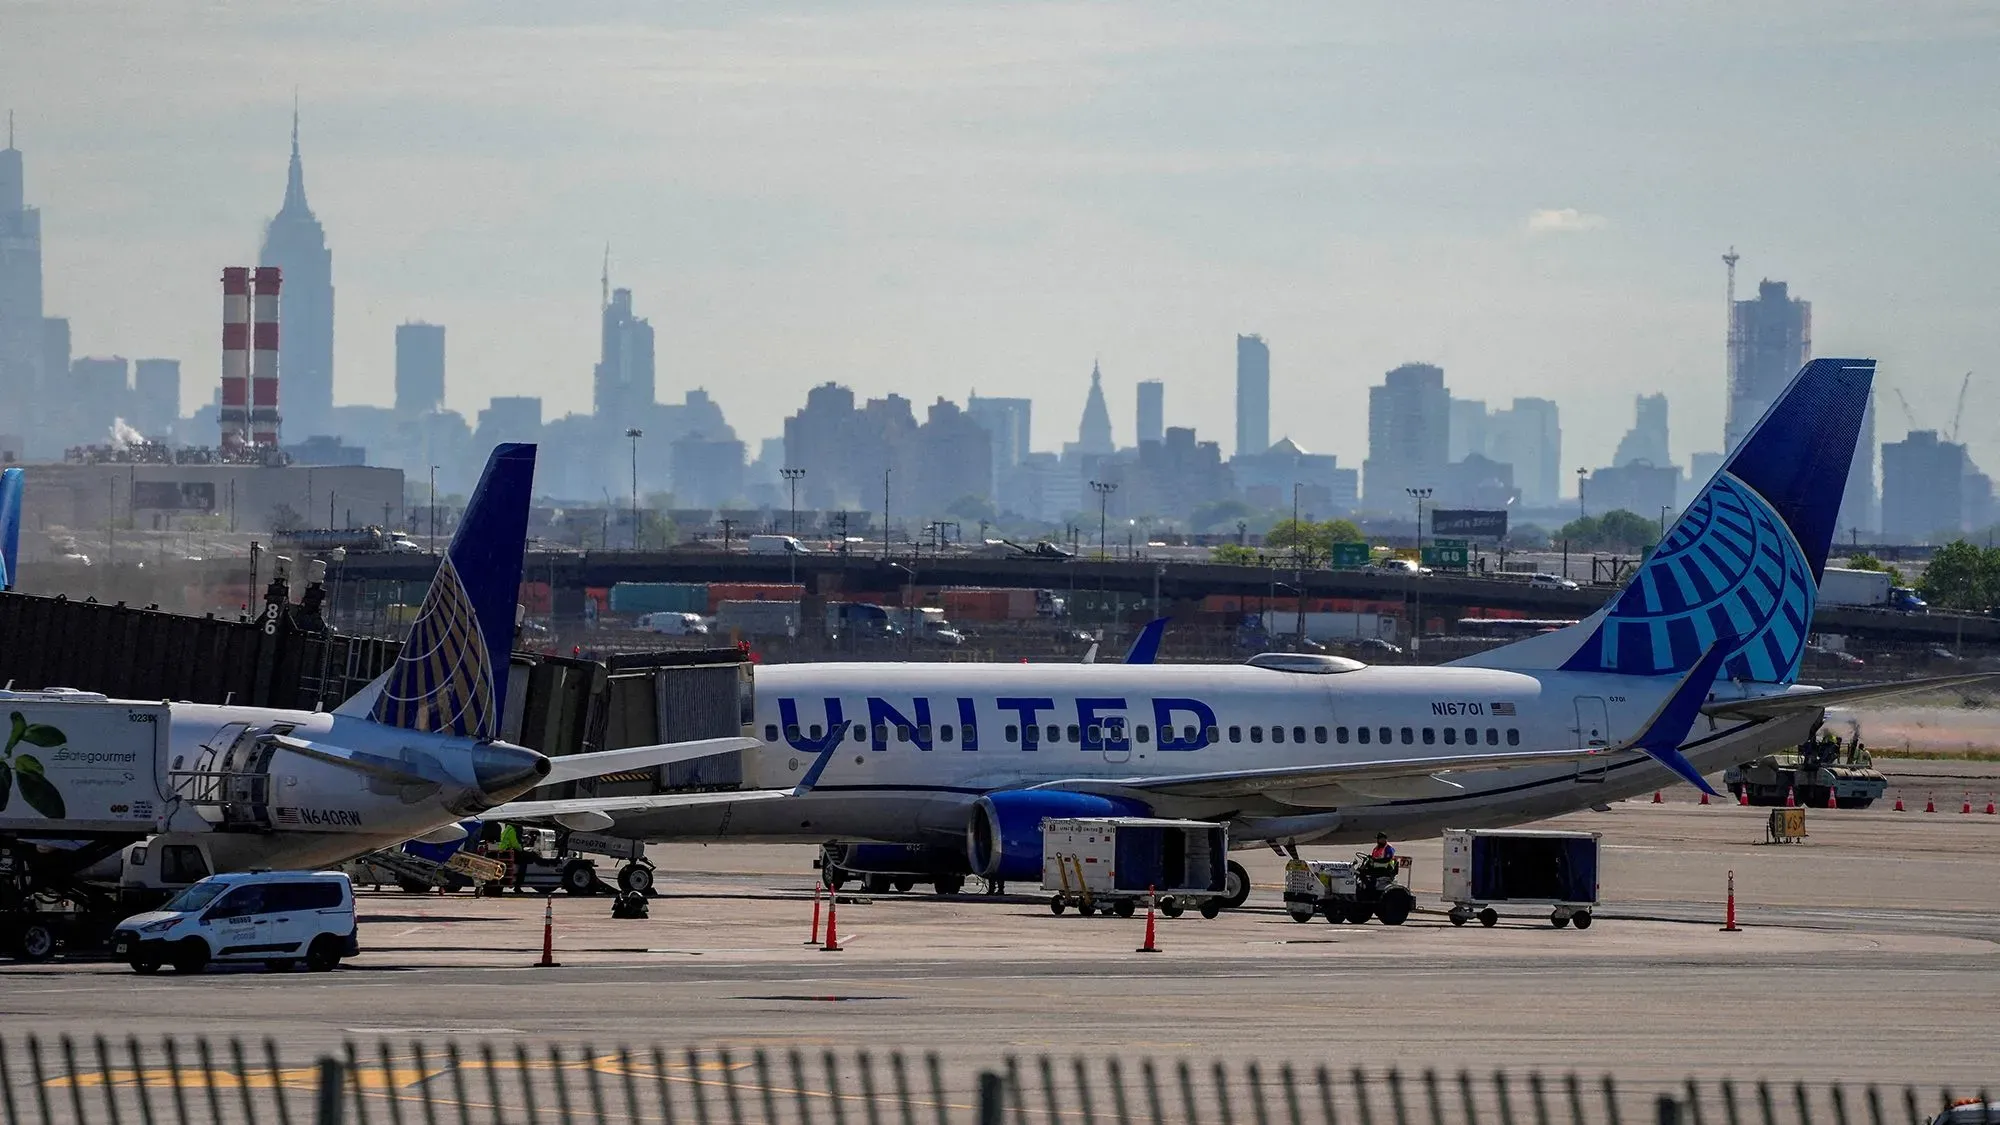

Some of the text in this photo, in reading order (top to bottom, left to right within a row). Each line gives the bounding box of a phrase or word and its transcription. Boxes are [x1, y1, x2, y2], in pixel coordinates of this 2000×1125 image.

[1431, 702, 1484, 716] N16701
[777, 697, 1218, 752] UNITED
[300, 807, 362, 826] N640RW
